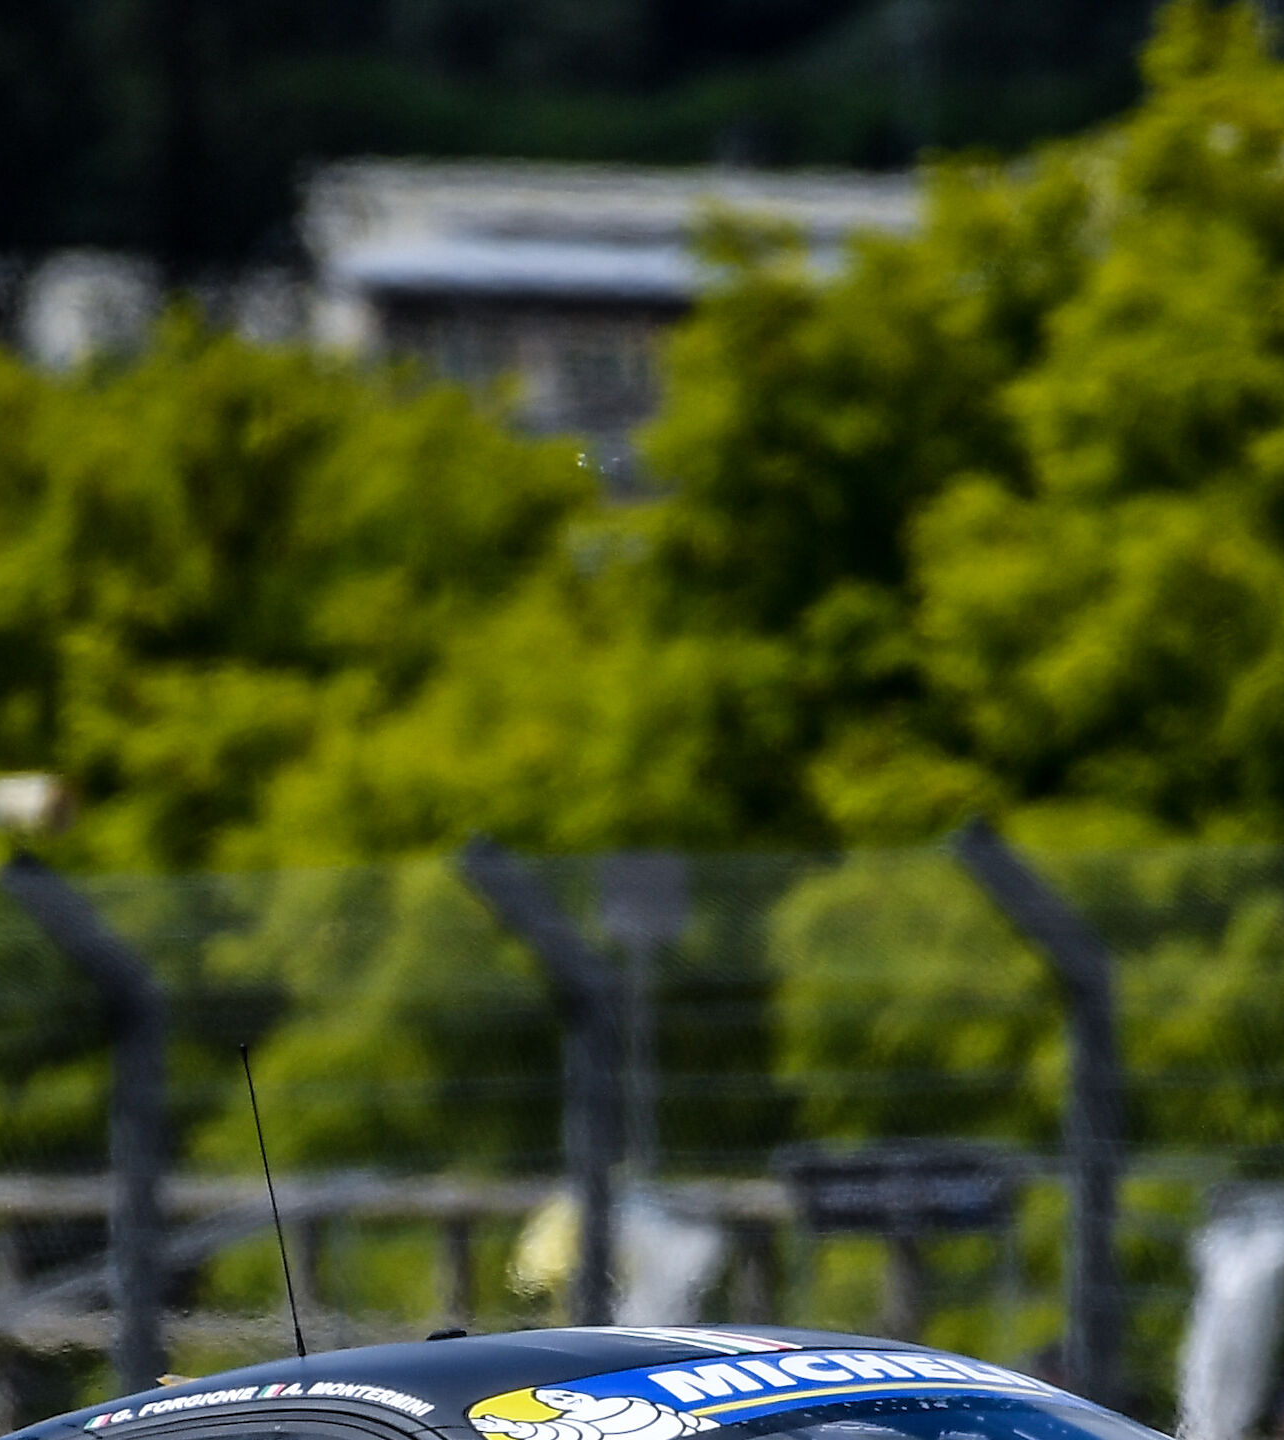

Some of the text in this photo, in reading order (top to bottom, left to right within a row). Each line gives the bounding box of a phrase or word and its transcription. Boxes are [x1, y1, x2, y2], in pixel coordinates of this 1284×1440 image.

[138, 1386, 259, 1418] FORGIONE
[281, 1381, 436, 1418] A. MONTERMINI
